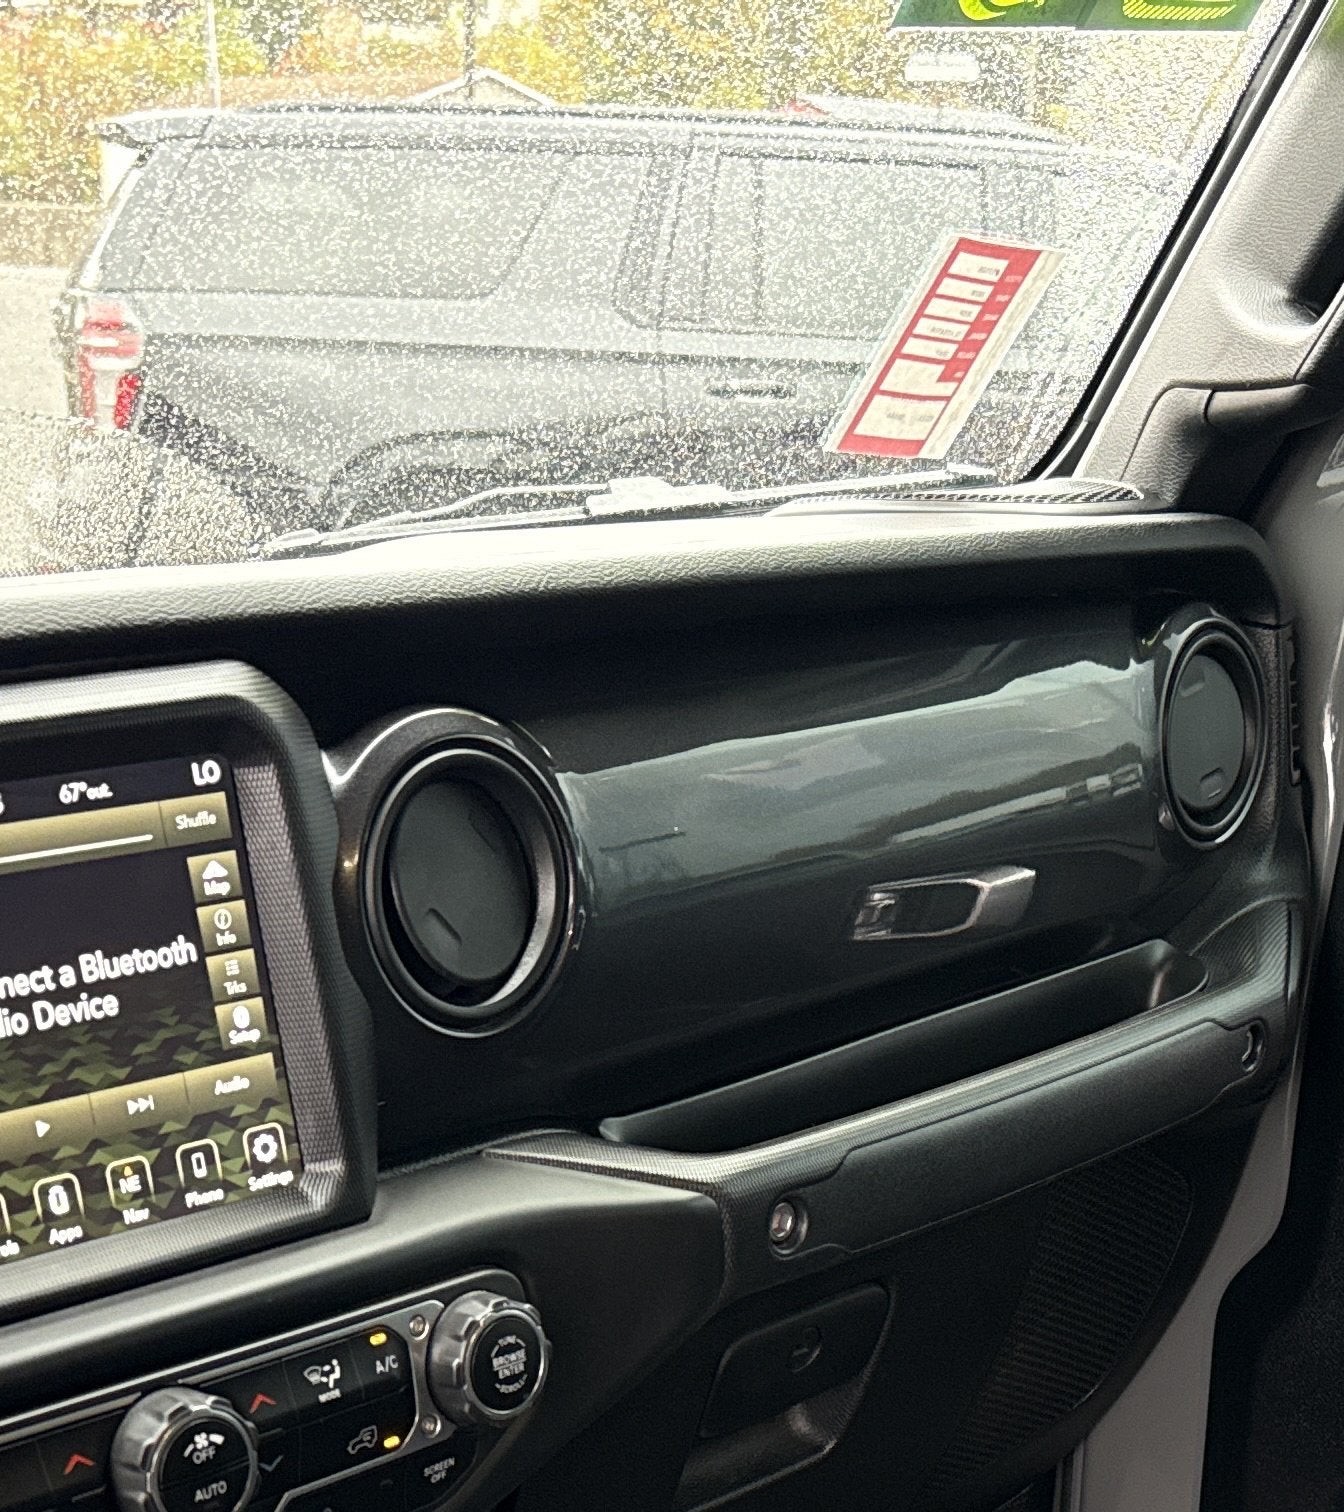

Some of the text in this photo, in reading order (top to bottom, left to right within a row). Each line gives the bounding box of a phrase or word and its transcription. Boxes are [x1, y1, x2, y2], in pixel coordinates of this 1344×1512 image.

[191, 759, 222, 787] LO
[175, 810, 217, 830] Shuffle
[216, 931, 237, 946] Info
[58, 965, 77, 989] a
[78, 934, 199, 985] Bluetooth
[32, 991, 120, 1032] Device
[214, 1075, 250, 1096] Audio
[118, 1174, 142, 1195] NE
[247, 1169, 294, 1192] Settings
[184, 1188, 225, 1209] Phone
[122, 1206, 150, 1226] Nav
[48, 1224, 84, 1246] Apps
[375, 1354, 399, 1375] A/C
[498, 1361, 525, 1379] ENTER
[192, 1445, 216, 1465] OFF
[424, 1457, 455, 1477] SCREEN
[430, 1470, 447, 1484] OFF
[194, 1480, 227, 1503] AUTO
